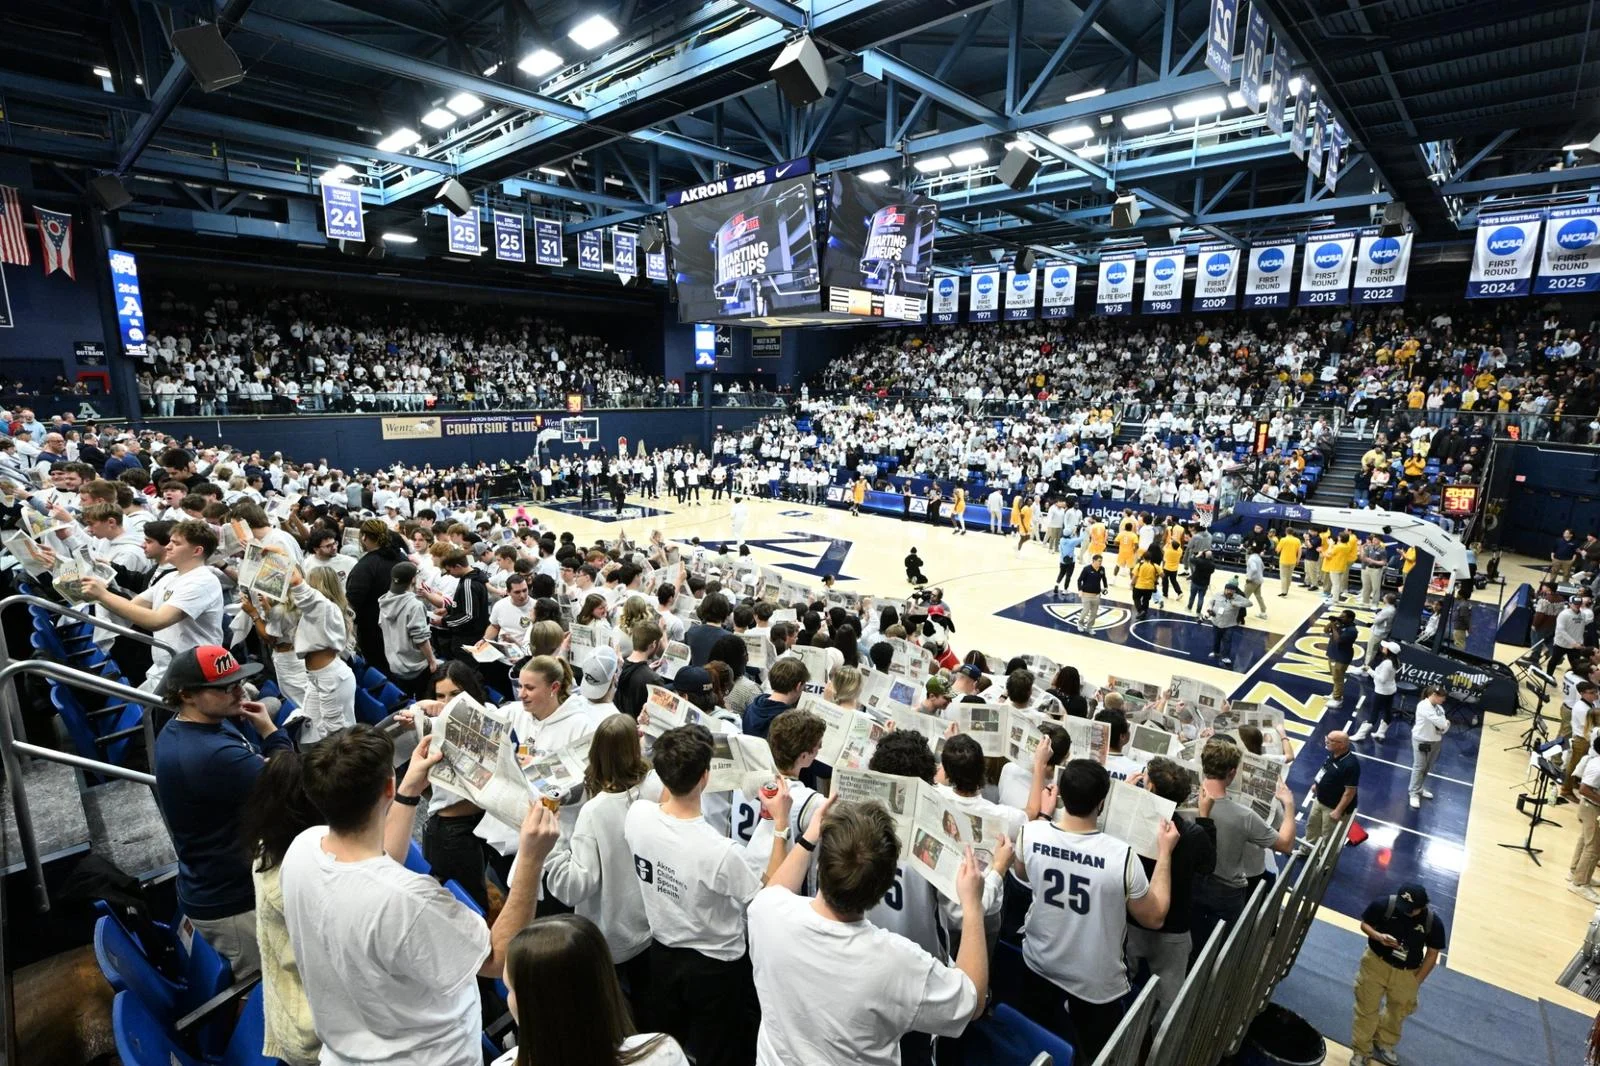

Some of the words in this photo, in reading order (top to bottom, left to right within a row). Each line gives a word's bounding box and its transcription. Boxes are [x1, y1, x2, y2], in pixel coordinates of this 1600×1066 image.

[680, 180, 728, 204] AKRON
[733, 170, 766, 190] ZIPS
[330, 208, 357, 228] 24
[1499, 213, 1540, 223] BASKETBALL
[454, 225, 476, 243] 25
[1559, 231, 1595, 243] NCAA
[500, 234, 520, 251] 25
[541, 239, 558, 256] 31
[1490, 239, 1523, 250] NCAA
[581, 246, 600, 262] 42
[1315, 254, 1342, 263] NCAA
[1371, 248, 1399, 258] NCAA
[1557, 252, 1588, 261] FIRST
[616, 252, 633, 266] 44
[650, 257, 665, 270] 55
[1260, 259, 1284, 267] NCAA
[1488, 259, 1517, 268] FIRST
[1155, 267, 1176, 276] NCAA
[1207, 263, 1230, 272] NCAA
[1551, 261, 1589, 271] ROUND
[1107, 271, 1127, 280] NCAA
[1483, 267, 1518, 277] ROUND
[1311, 279, 1339, 287] ROUND
[1366, 275, 1395, 283] ROUND
[1548, 276, 1587, 289] 2025
[1479, 282, 1516, 294] 2024
[1309, 292, 1337, 303] 2013
[1362, 289, 1394, 299] 2022
[1201, 298, 1227, 308] 2009
[1254, 295, 1278, 305] 2011
[119, 296, 143, 317] A
[1050, 307, 1067, 315] 1973
[1104, 304, 1123, 313] 1975
[1151, 302, 1172, 310] 1986
[1012, 309, 1028, 317] 1972
[385, 424, 415, 432] Wentz
[446, 422, 508, 436] COURTSIDE
[511, 421, 538, 432] CLUB
[1445, 487, 1475, 498] 20:00
[1450, 498, 1469, 510] 30
[1086, 506, 1124, 520] uakro
[737, 803, 755, 842] 2
[1033, 842, 1105, 869] FREEMAN
[657, 861, 676, 875] Akron
[657, 869, 688, 891] Children's
[657, 877, 679, 893] Sports
[657, 885, 680, 900] Health
[884, 868, 903, 911] 5
[1043, 868, 1091, 915] 25
